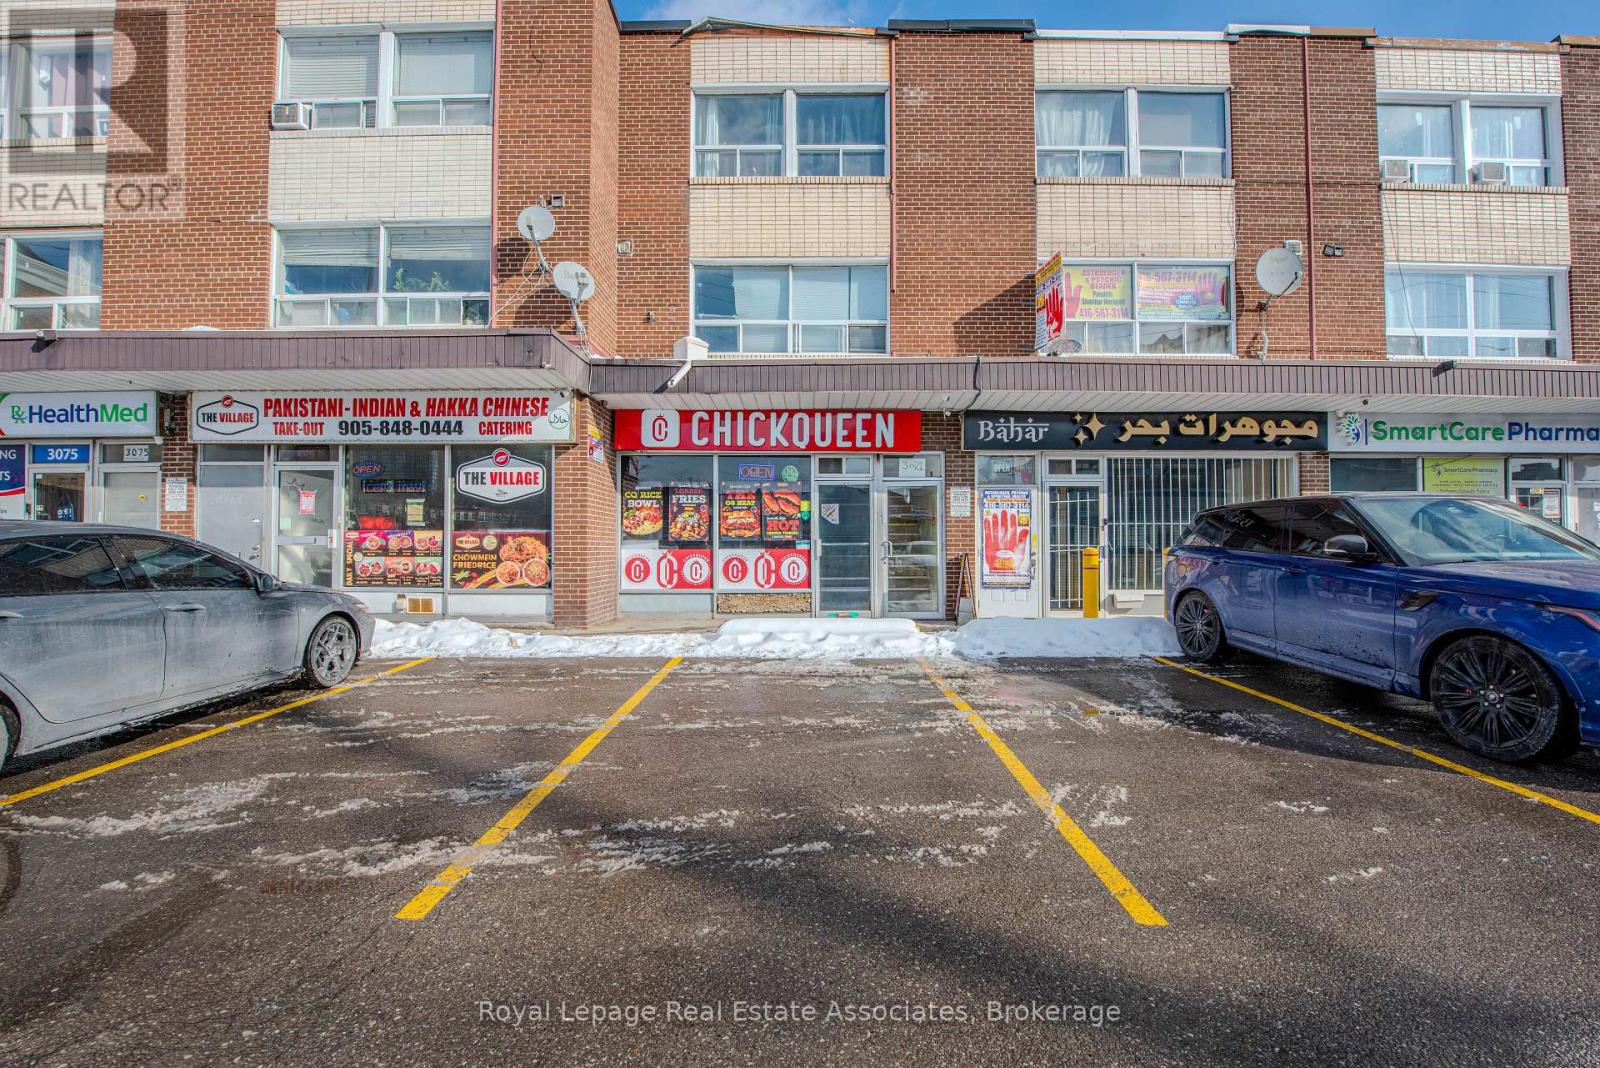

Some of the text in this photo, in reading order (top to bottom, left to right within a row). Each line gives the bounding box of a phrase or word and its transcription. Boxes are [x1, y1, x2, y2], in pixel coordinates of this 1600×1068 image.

[28, 403, 148, 424] HealthMed
[264, 397, 550, 418] PAKISTANI-INDIAN & HAKKA CHINESE
[202, 412, 254, 423] THE VILLAGE
[272, 420, 532, 436] TAKE-OUT 905-848-0444 CATERING
[692, 411, 896, 449] CHICKQUEEN
[977, 416, 1050, 443] Bahar
[1178, 412, 1318, 445] مجوهرات
[1508, 422, 1600, 441] Pharma
[47, 448, 78, 460] 3075
[126, 448, 150, 457] 3075
[352, 465, 380, 474] OPEN
[463, 472, 539, 486] THE VILLAGE
[627, 500, 660, 508] BOWL
[672, 494, 706, 504] FRIES
[766, 520, 800, 531] HOT
